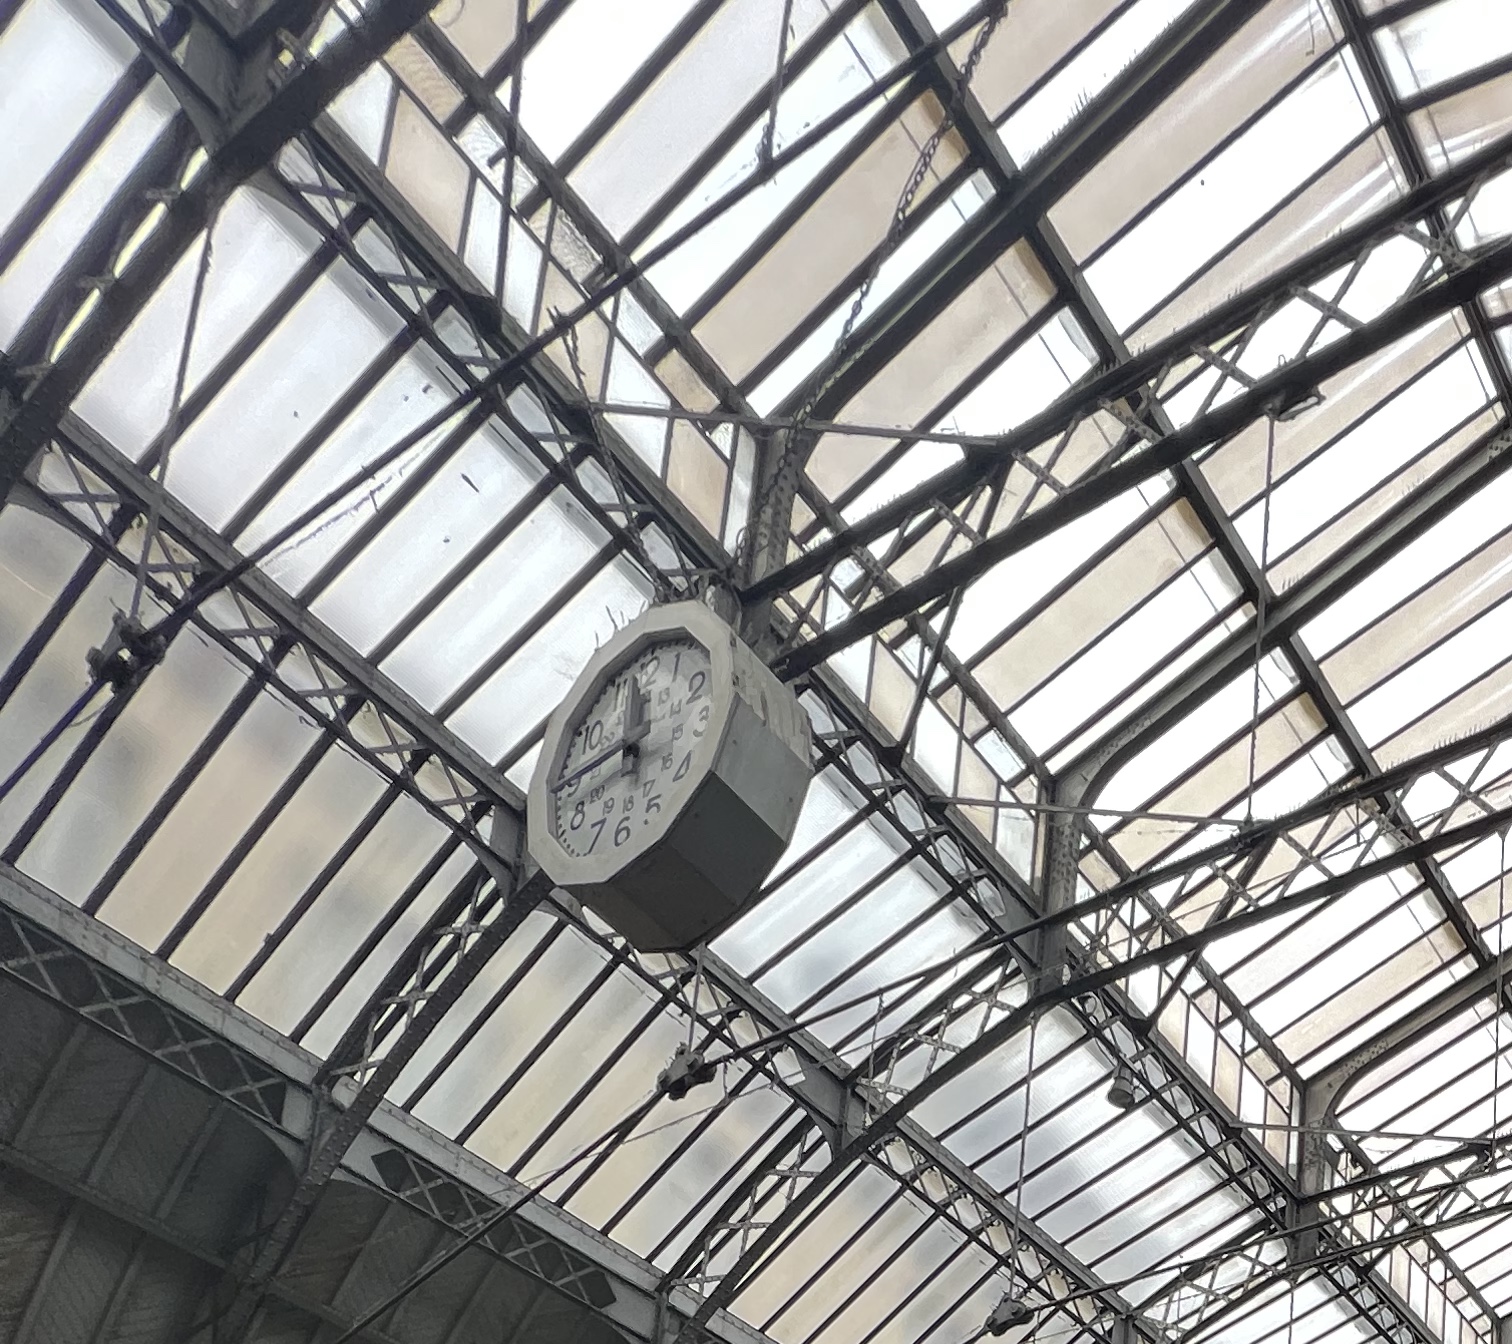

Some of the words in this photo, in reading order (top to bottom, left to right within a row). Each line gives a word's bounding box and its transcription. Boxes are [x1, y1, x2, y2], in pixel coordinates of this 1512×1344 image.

[686, 671, 705, 704] 2
[692, 705, 709, 737] 3
[673, 750, 691, 782] 4
[570, 801, 585, 831] 8
[614, 816, 631, 847] 6
[588, 818, 607, 854] 7
